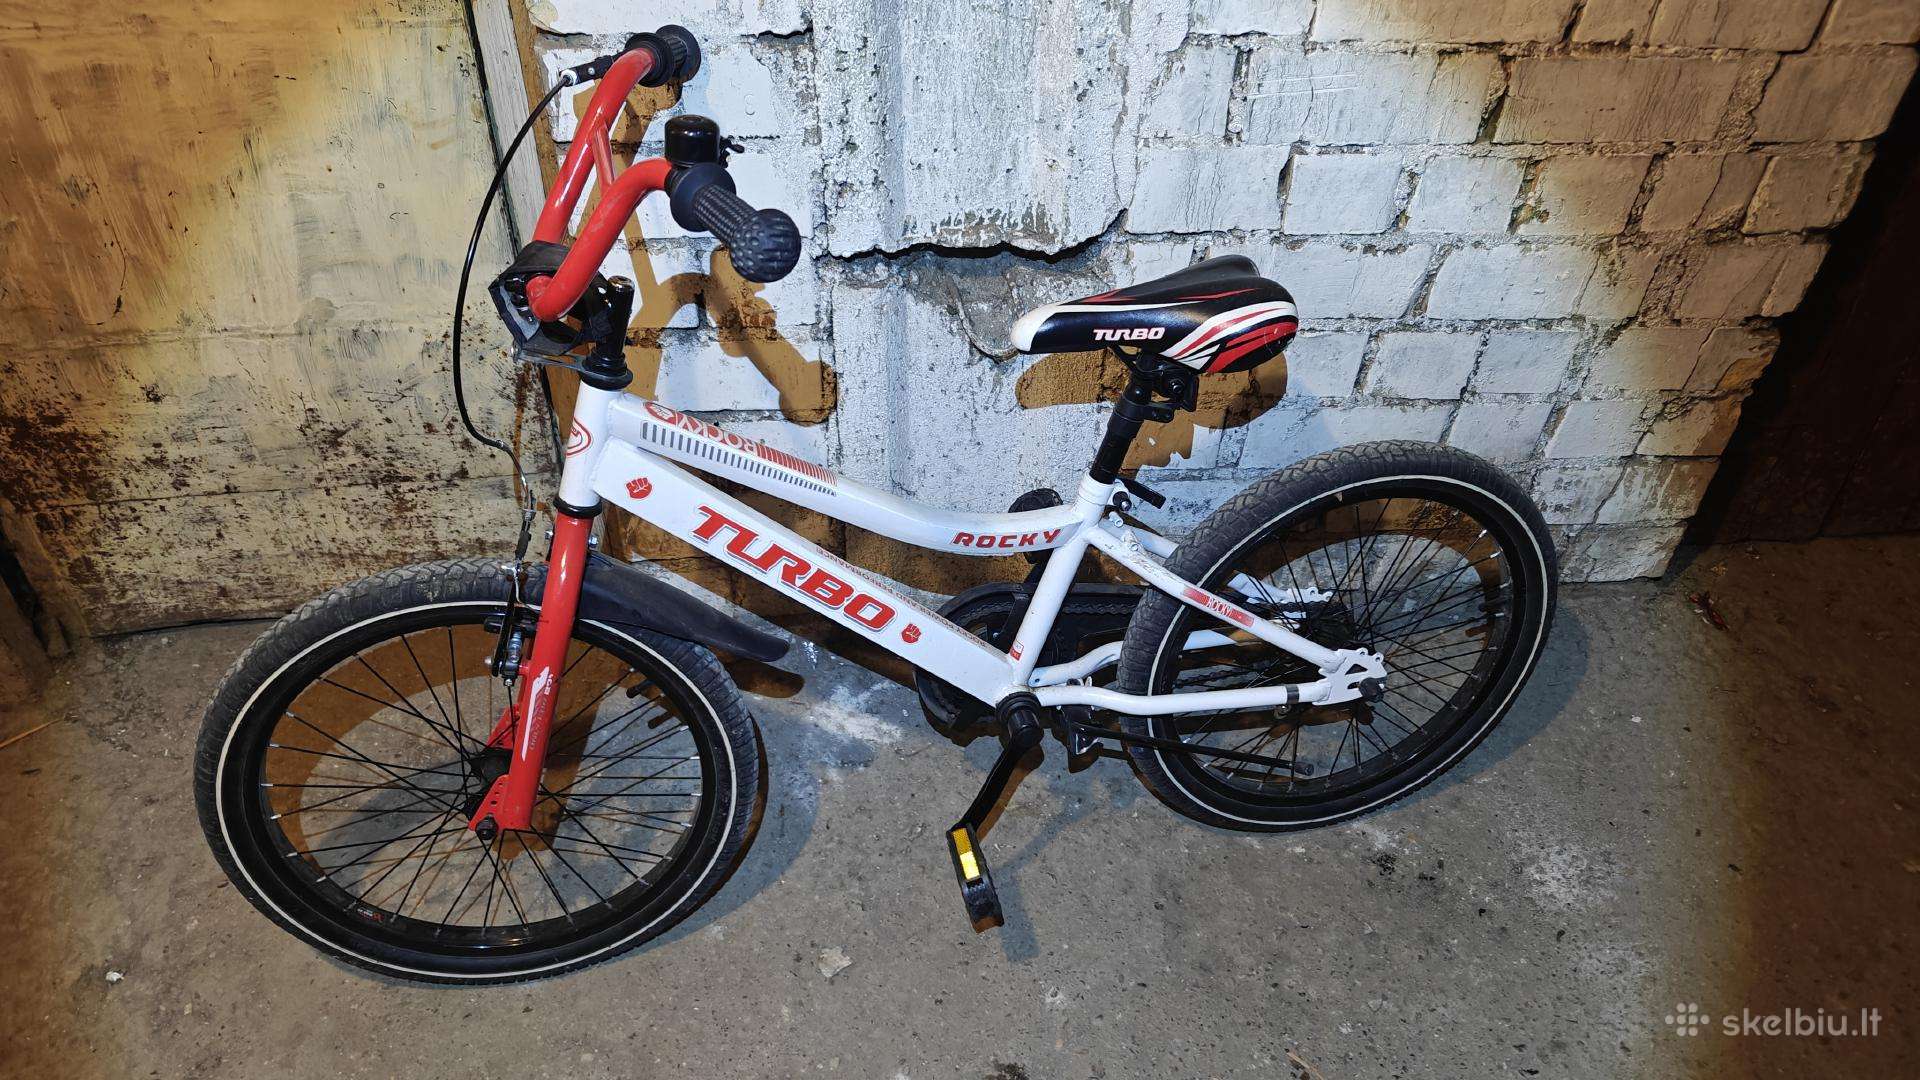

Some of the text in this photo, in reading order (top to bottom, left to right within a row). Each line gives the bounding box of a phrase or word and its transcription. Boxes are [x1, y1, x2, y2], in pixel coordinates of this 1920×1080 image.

[1093, 326, 1166, 341] TURBO
[675, 411, 757, 453] ROCKY
[952, 528, 1061, 548] ROCKY
[691, 505, 897, 631] TURBO
[1207, 597, 1231, 617] ROCKY
